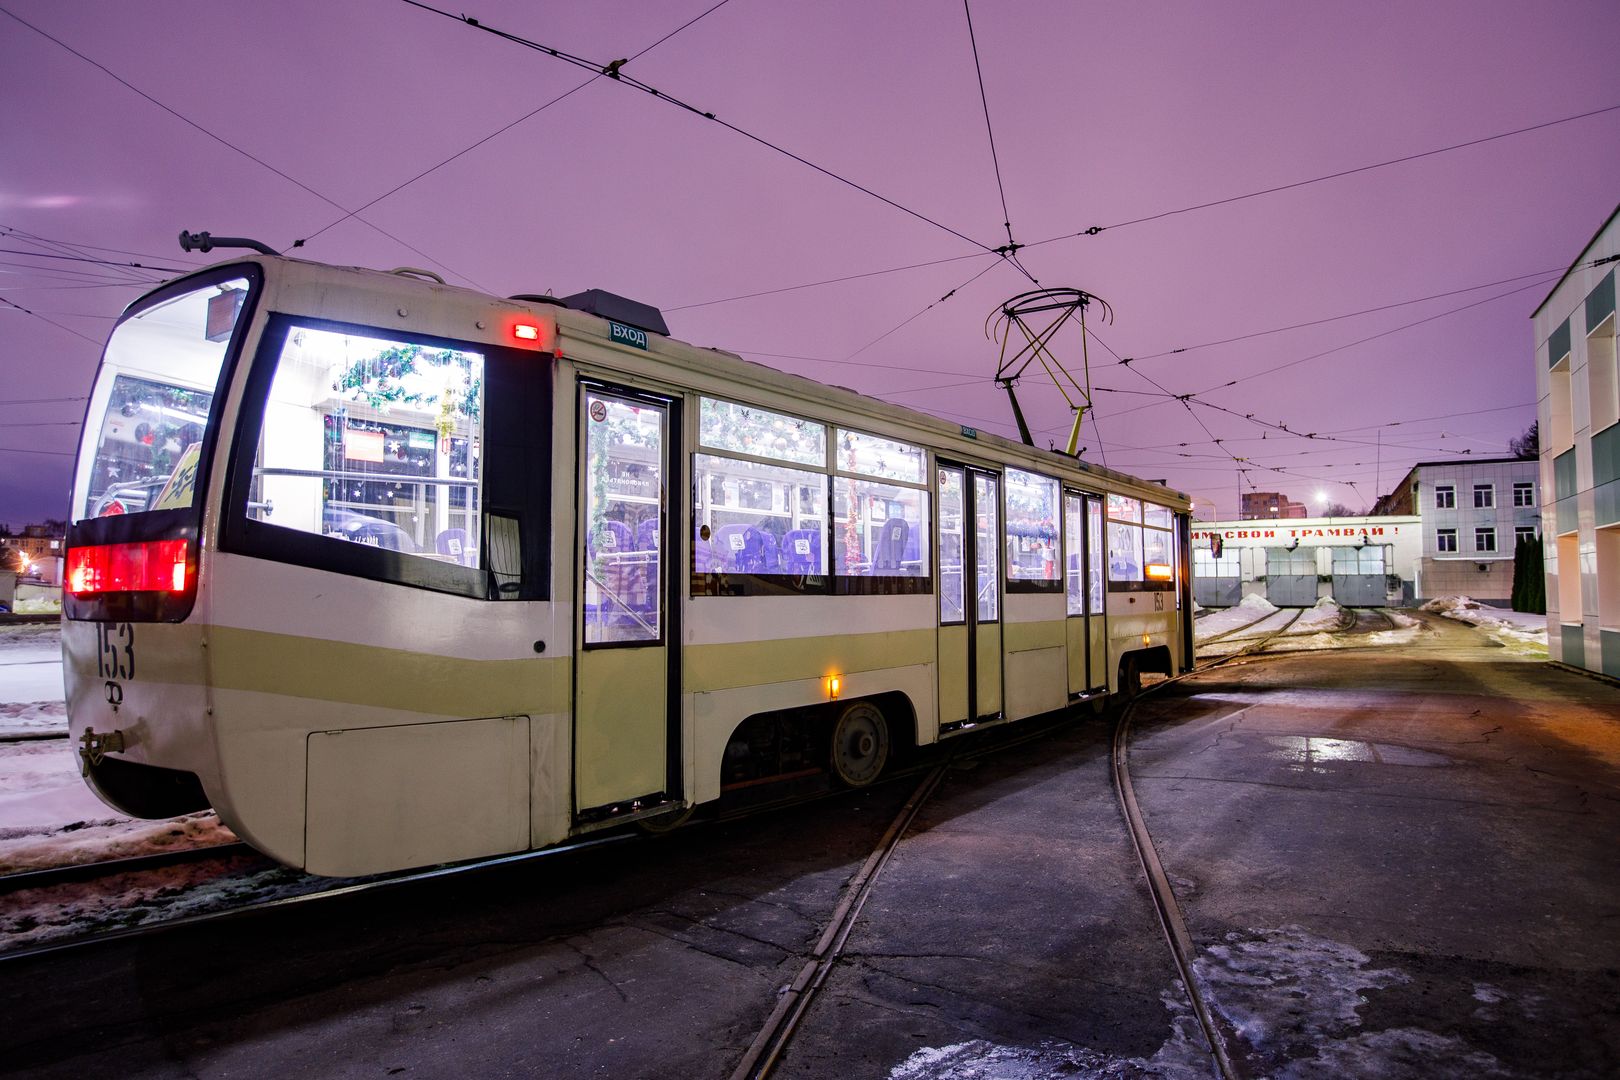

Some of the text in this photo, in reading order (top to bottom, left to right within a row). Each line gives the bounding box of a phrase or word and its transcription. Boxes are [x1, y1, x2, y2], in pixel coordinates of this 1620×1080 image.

[612, 324, 646, 347] ВХОД
[1288, 525, 1384, 537] ТРАМВАЙ
[1153, 592, 1164, 612] 153
[96, 621, 135, 681] 153
